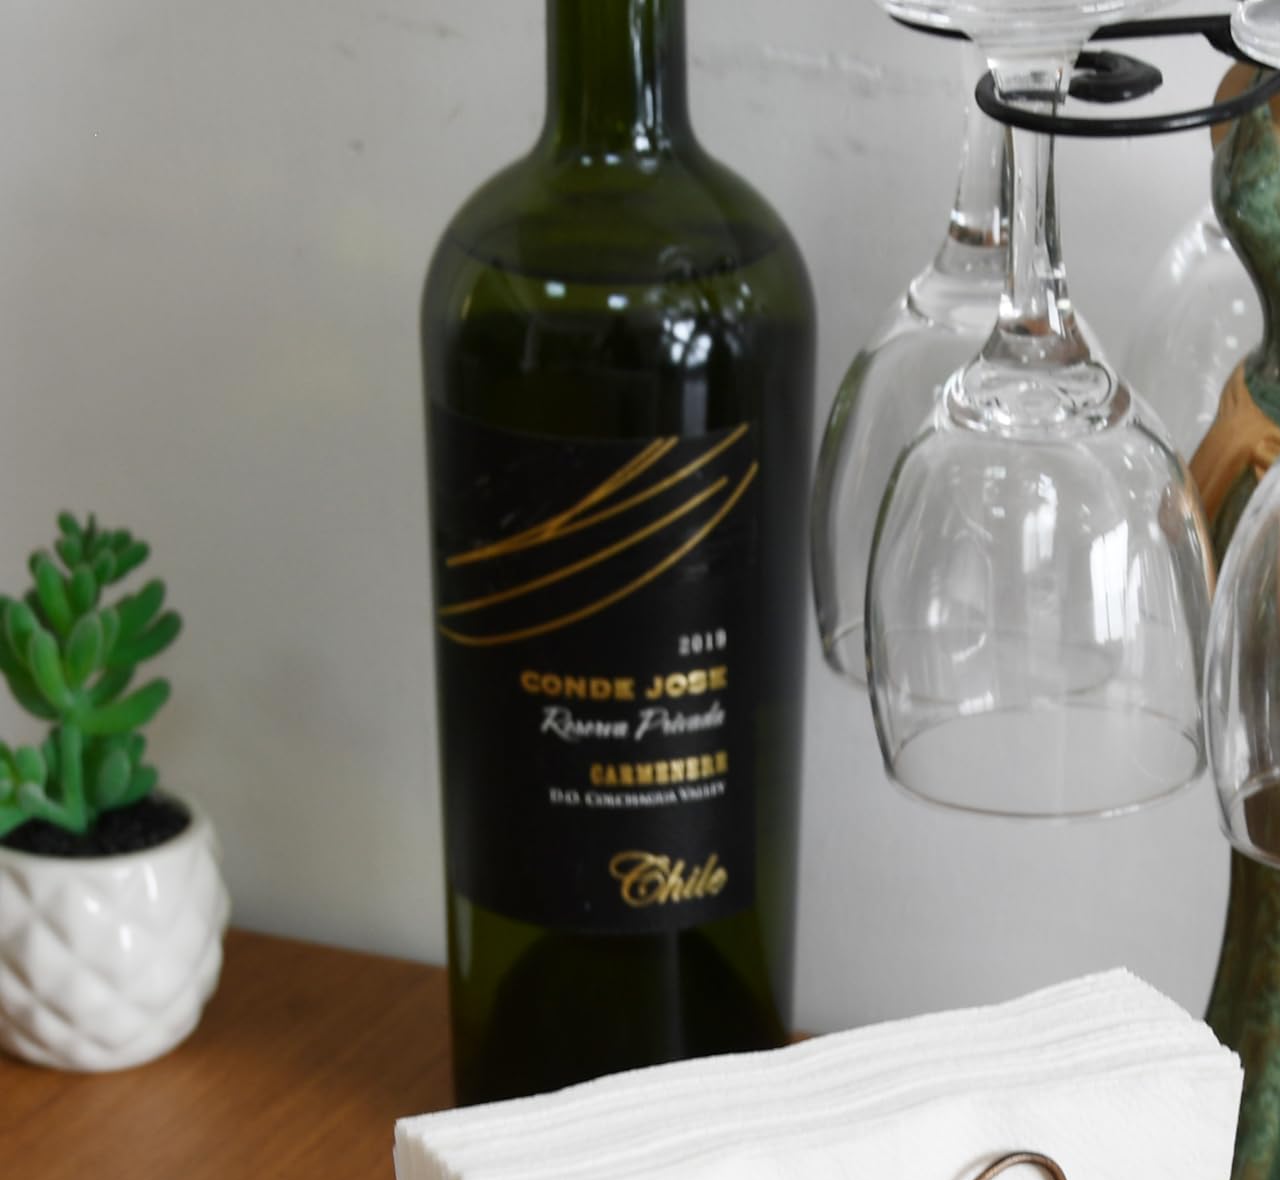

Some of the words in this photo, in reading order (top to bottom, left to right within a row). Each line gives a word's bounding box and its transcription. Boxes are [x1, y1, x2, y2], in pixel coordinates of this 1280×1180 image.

[520, 670, 635, 700] CONDE
[645, 665, 728, 699] JOSE
[541, 705, 630, 743] Reserva
[634, 700, 725, 741] Privada
[608, 849, 728, 908] Chile
